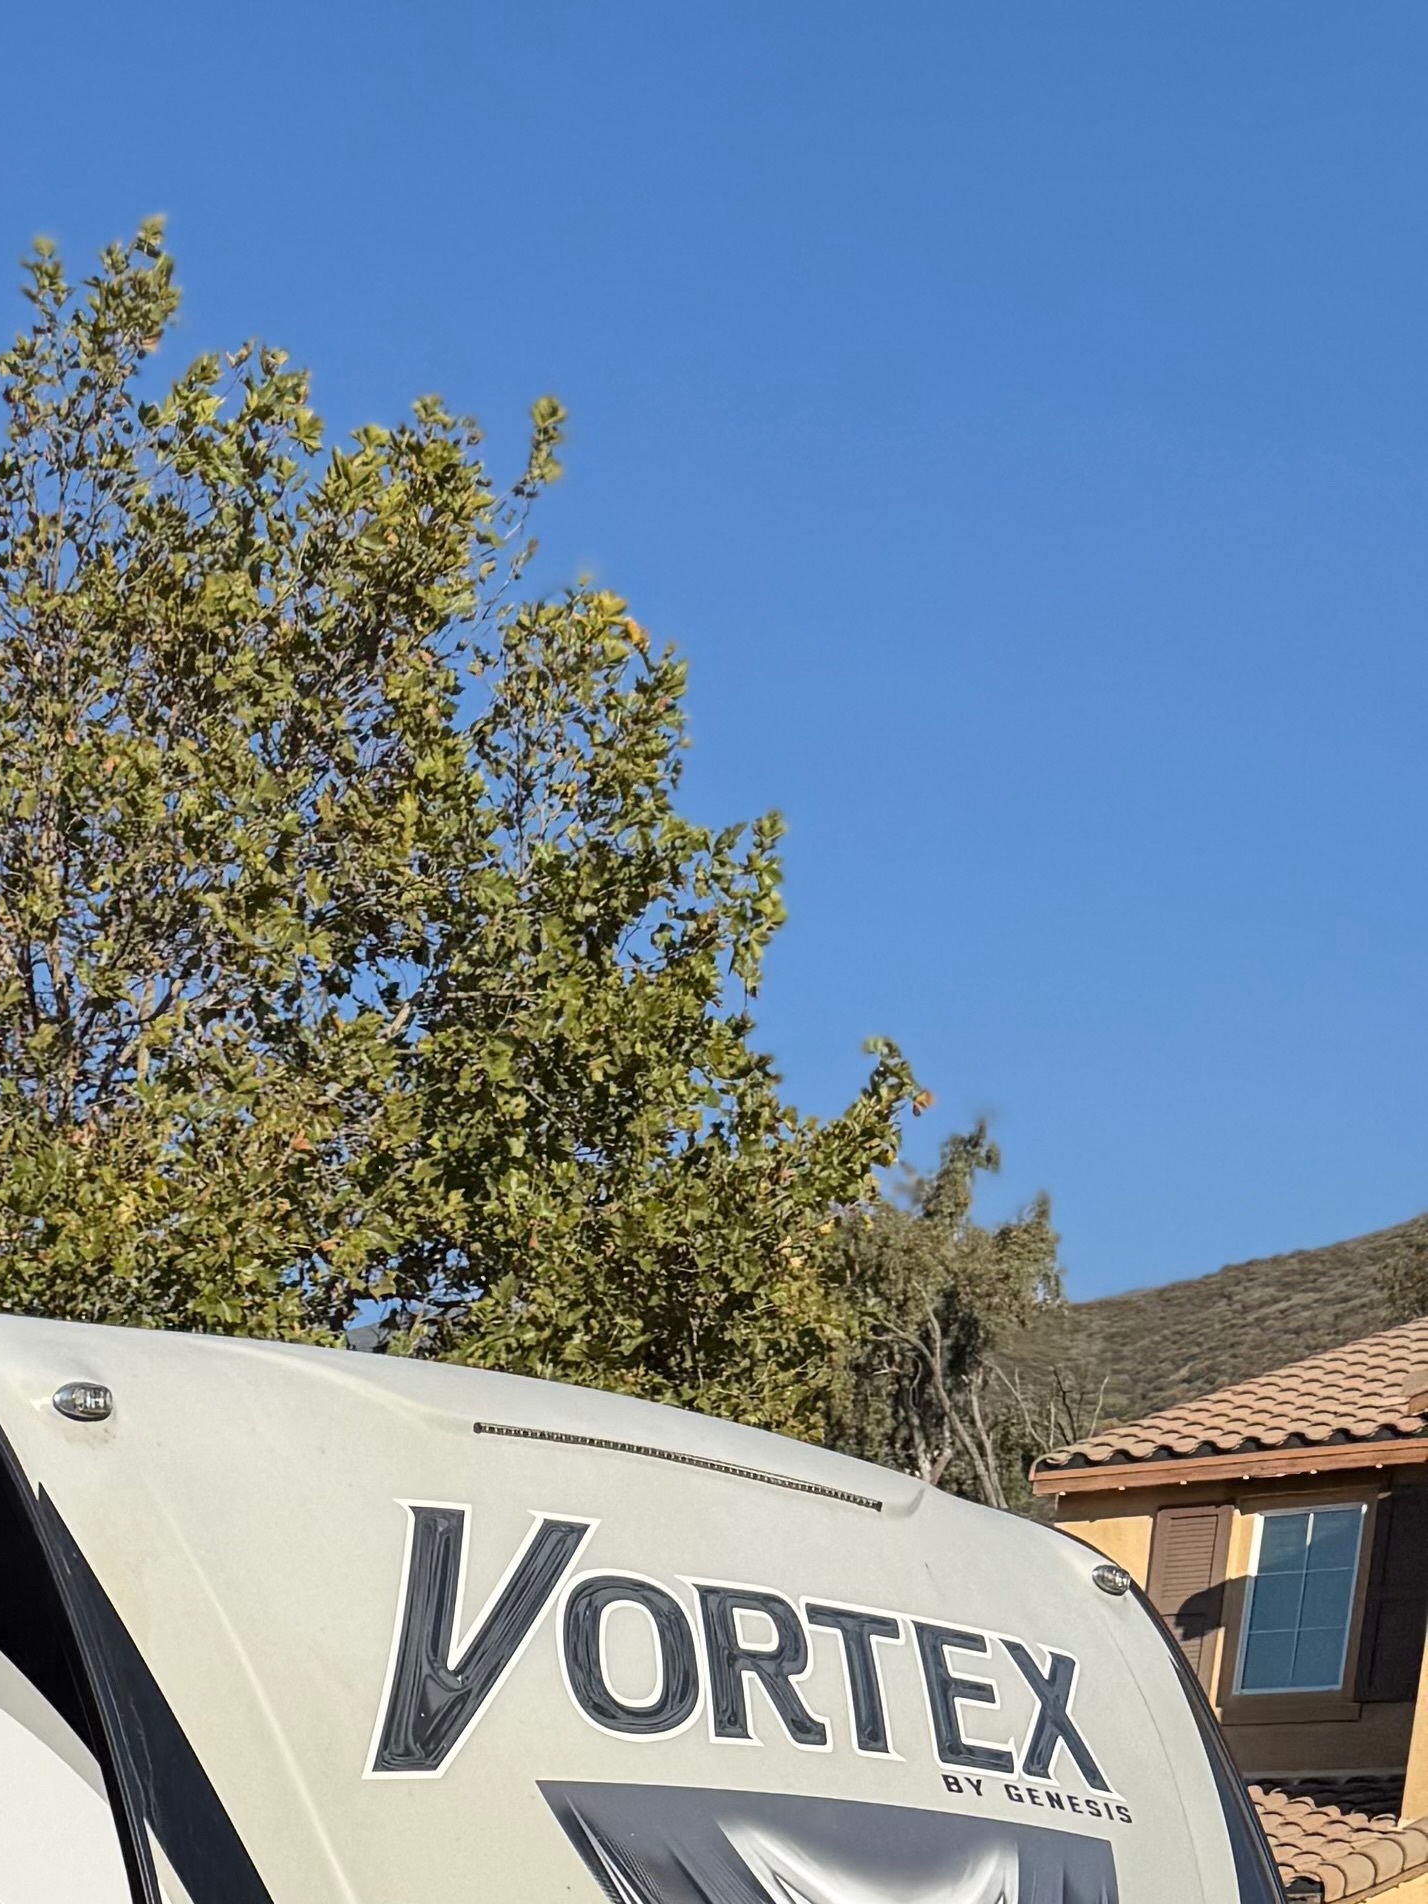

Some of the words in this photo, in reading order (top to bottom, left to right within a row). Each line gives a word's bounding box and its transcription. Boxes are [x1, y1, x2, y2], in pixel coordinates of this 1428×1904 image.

[363, 1499, 1124, 1799] VORTEX
[941, 1774, 983, 1797] BY
[1004, 1783, 1133, 1824] GENESIS
